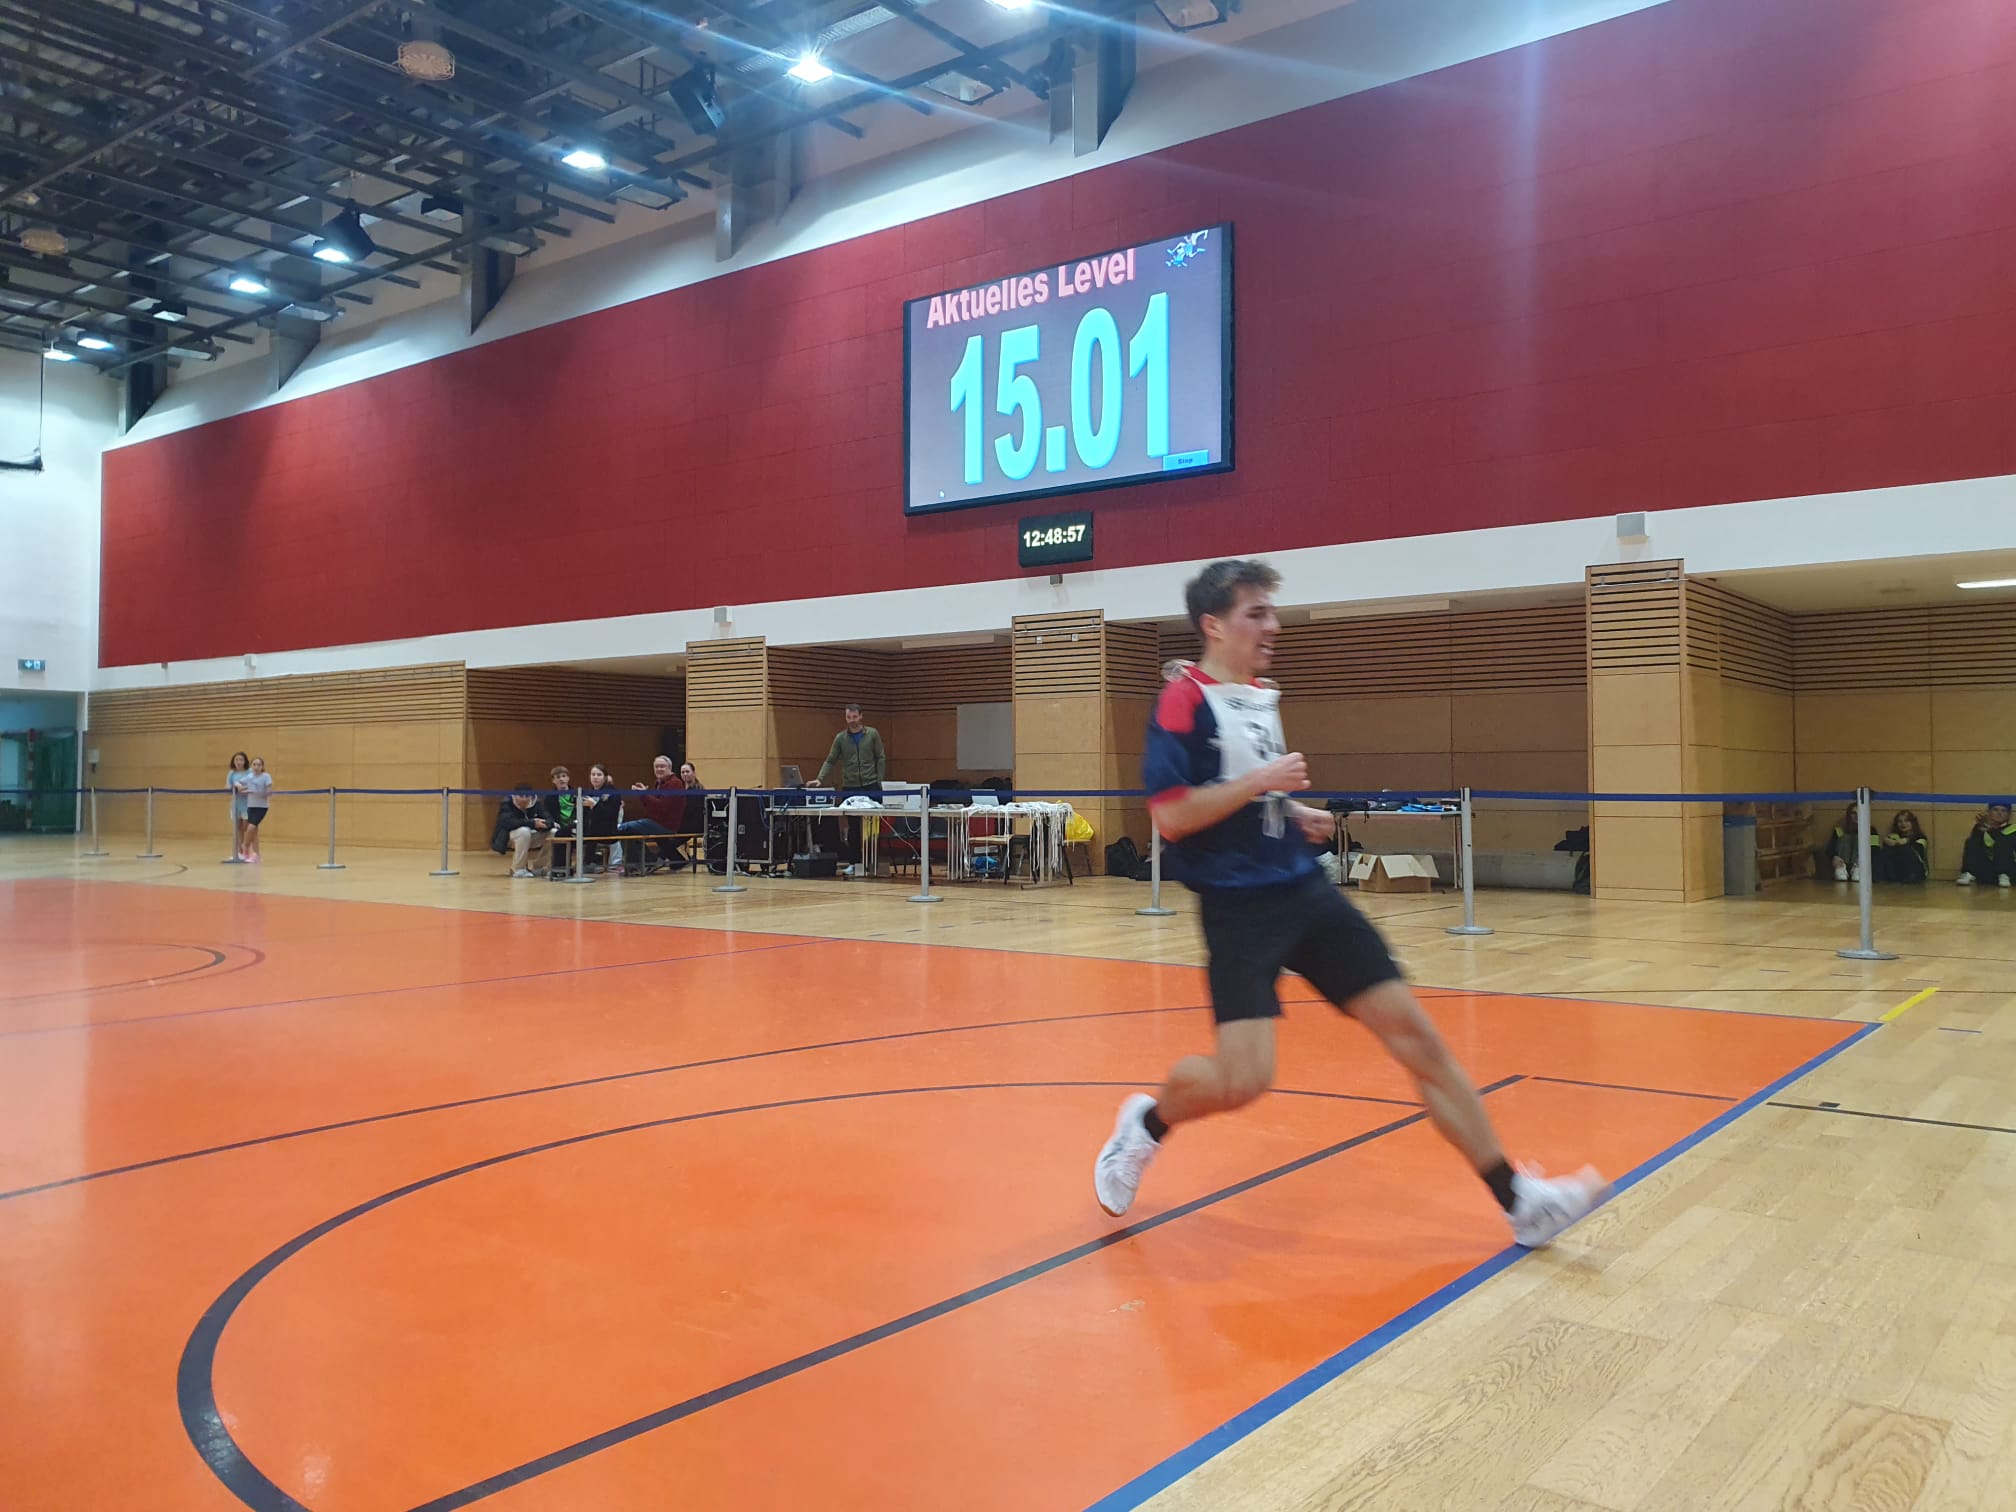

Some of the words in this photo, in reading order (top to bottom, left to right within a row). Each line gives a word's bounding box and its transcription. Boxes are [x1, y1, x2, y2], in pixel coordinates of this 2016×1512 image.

[926, 272, 1049, 329] Aktuelles
[1058, 248, 1136, 298] Level
[950, 291, 1169, 484] 15.01
[1023, 524, 1086, 548] 12:48:57
